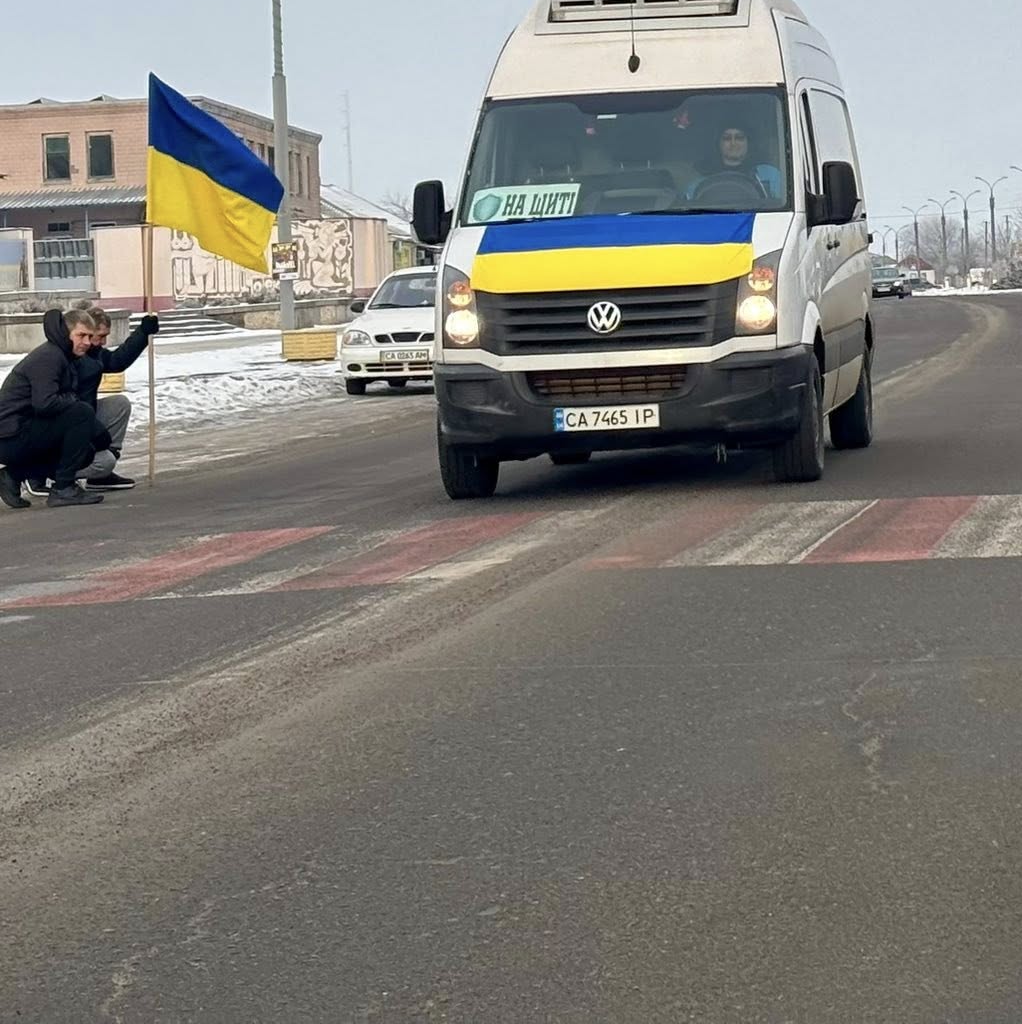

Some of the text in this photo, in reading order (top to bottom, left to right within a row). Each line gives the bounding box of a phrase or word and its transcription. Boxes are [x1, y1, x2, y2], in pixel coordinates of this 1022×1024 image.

[502, 192, 576, 218] НА ЩИТІ
[385, 352, 396, 360] CA
[566, 408, 654, 427] CA 7465 IP
